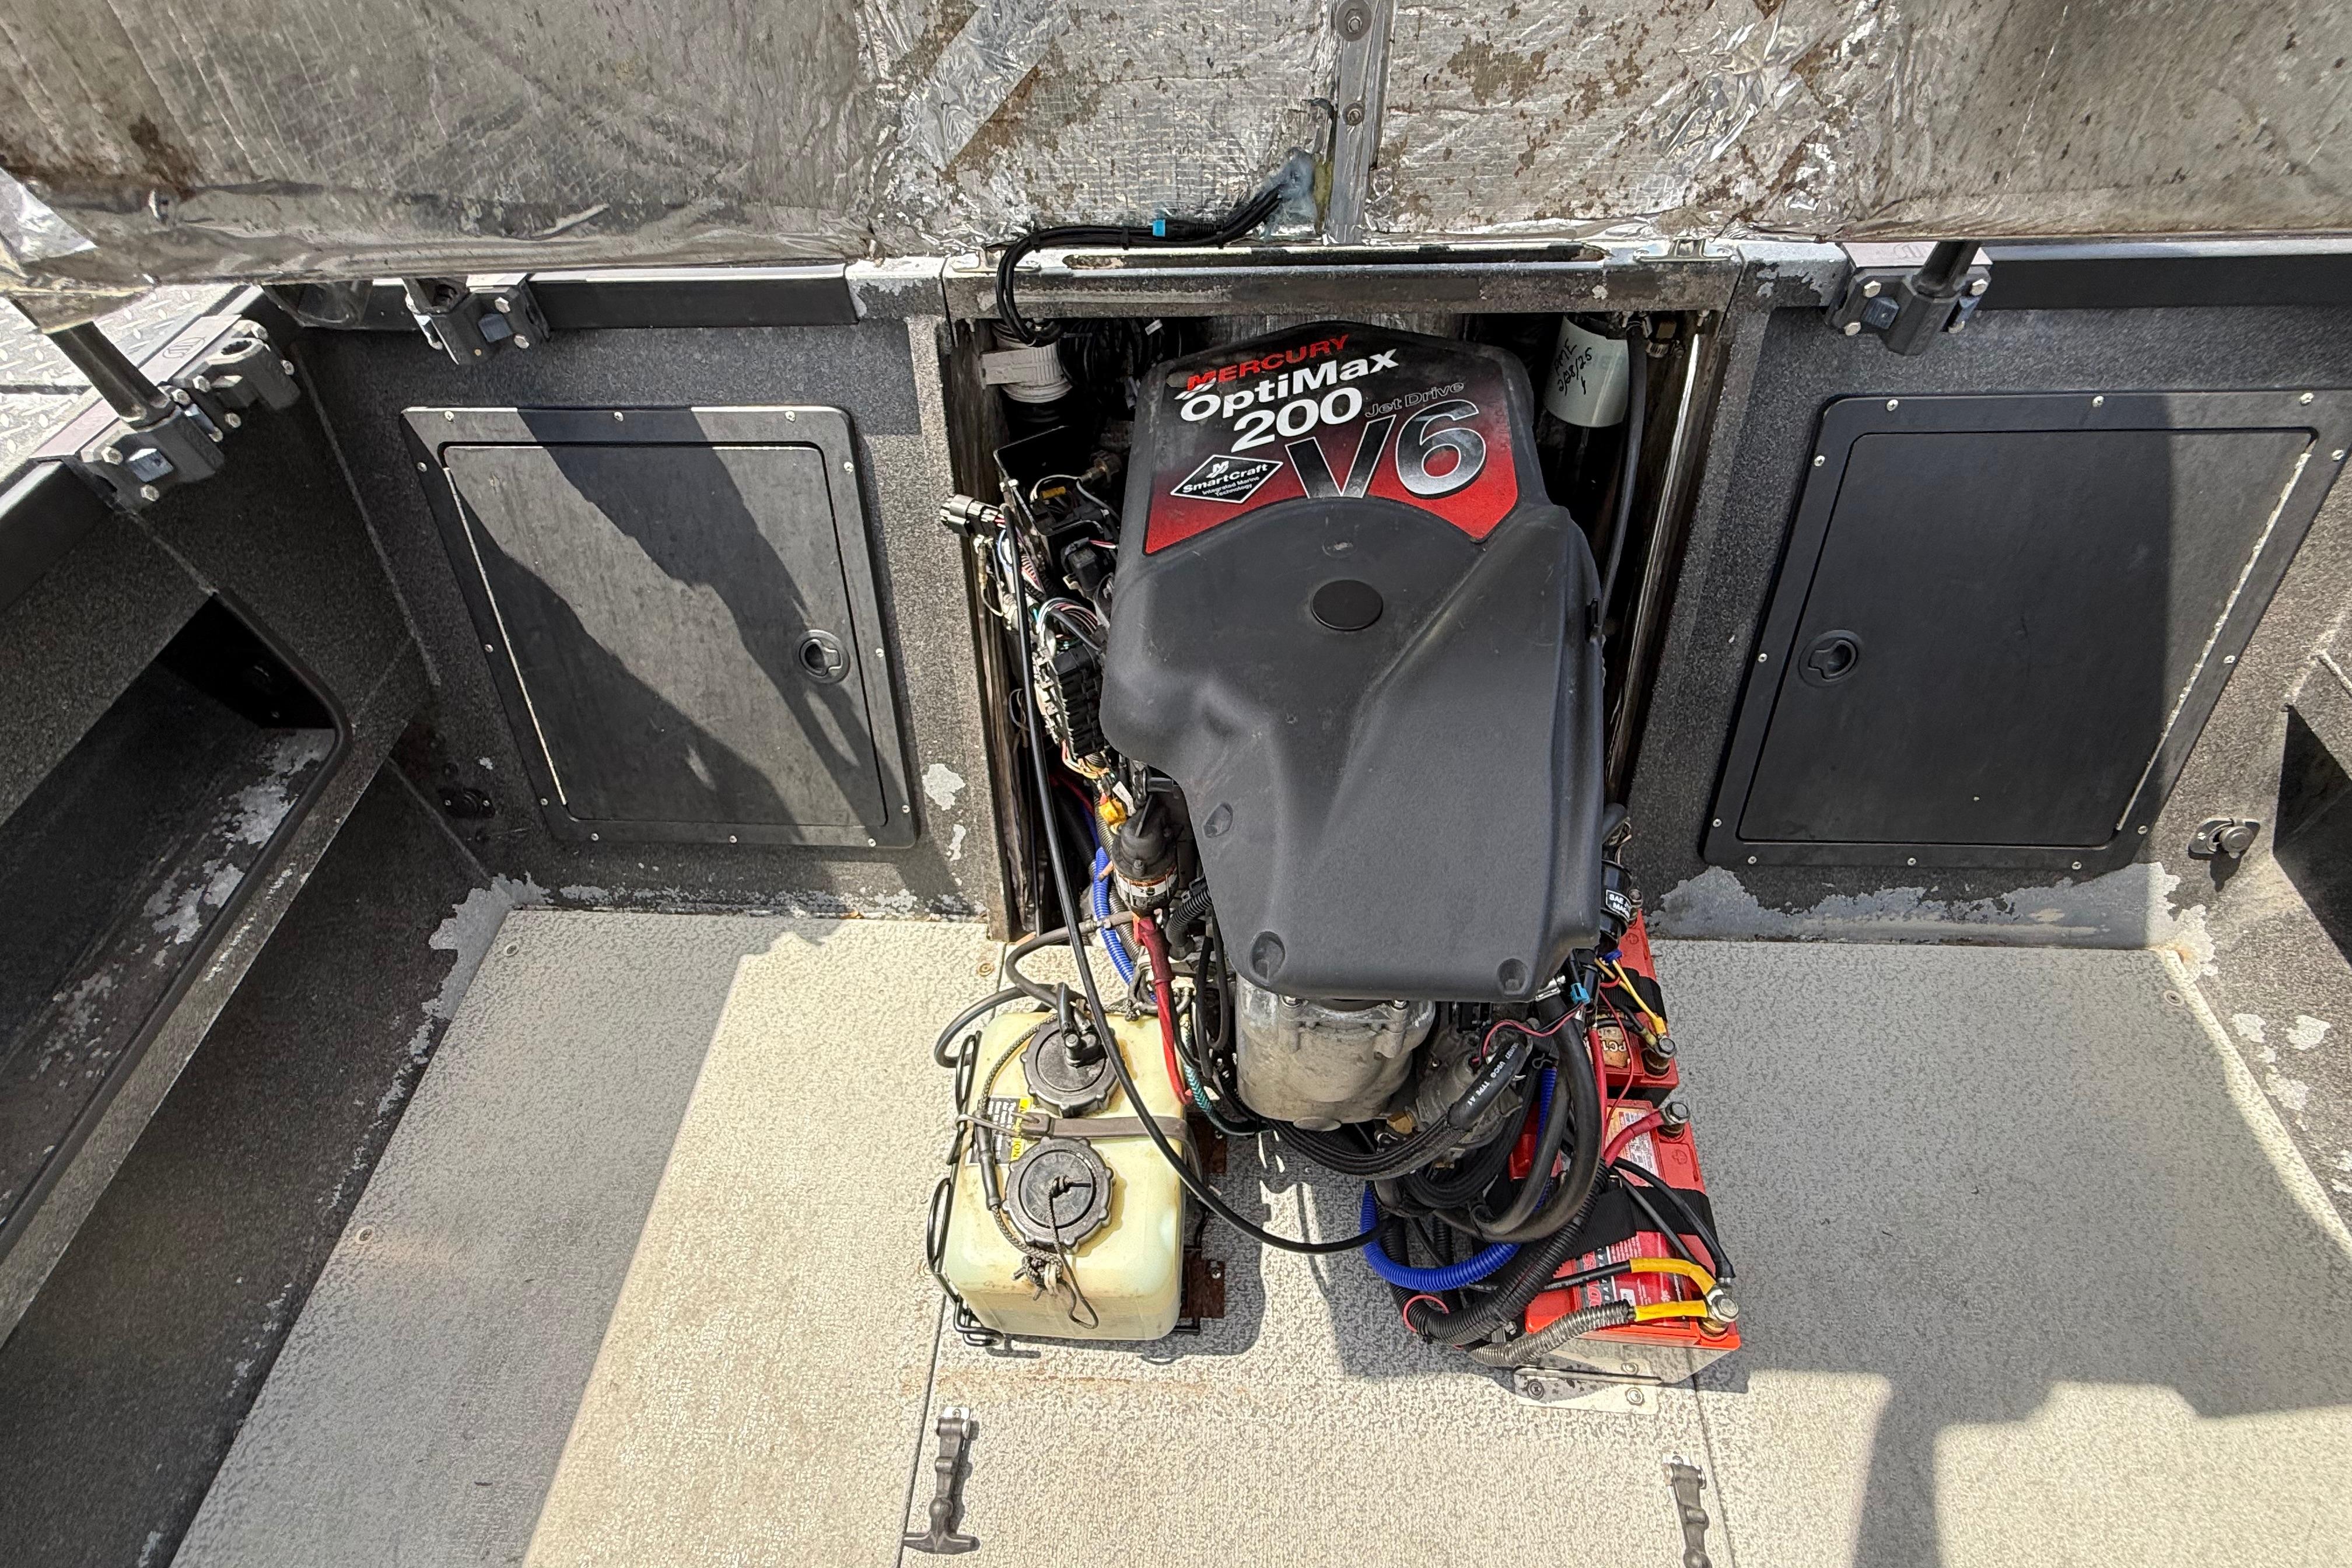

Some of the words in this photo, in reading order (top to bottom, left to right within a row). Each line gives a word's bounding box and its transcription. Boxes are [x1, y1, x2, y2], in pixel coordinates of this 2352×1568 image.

[1186, 334, 1349, 391] MERCURY
[1181, 349, 1399, 422] OptiMax
[1365, 398, 1402, 418] Jet
[1405, 382, 1465, 407] Drive
[1231, 387, 1363, 453] 200
[1285, 399, 1486, 500] V6
[1182, 464, 1268, 494] SmartCraft
[1202, 481, 1237, 495] Integrated
[1237, 476, 1260, 486] Marine
[1214, 484, 1252, 497] Technology
[1466, 1096, 1476, 1107] A1
[1475, 1080, 1490, 1097] TYPE
